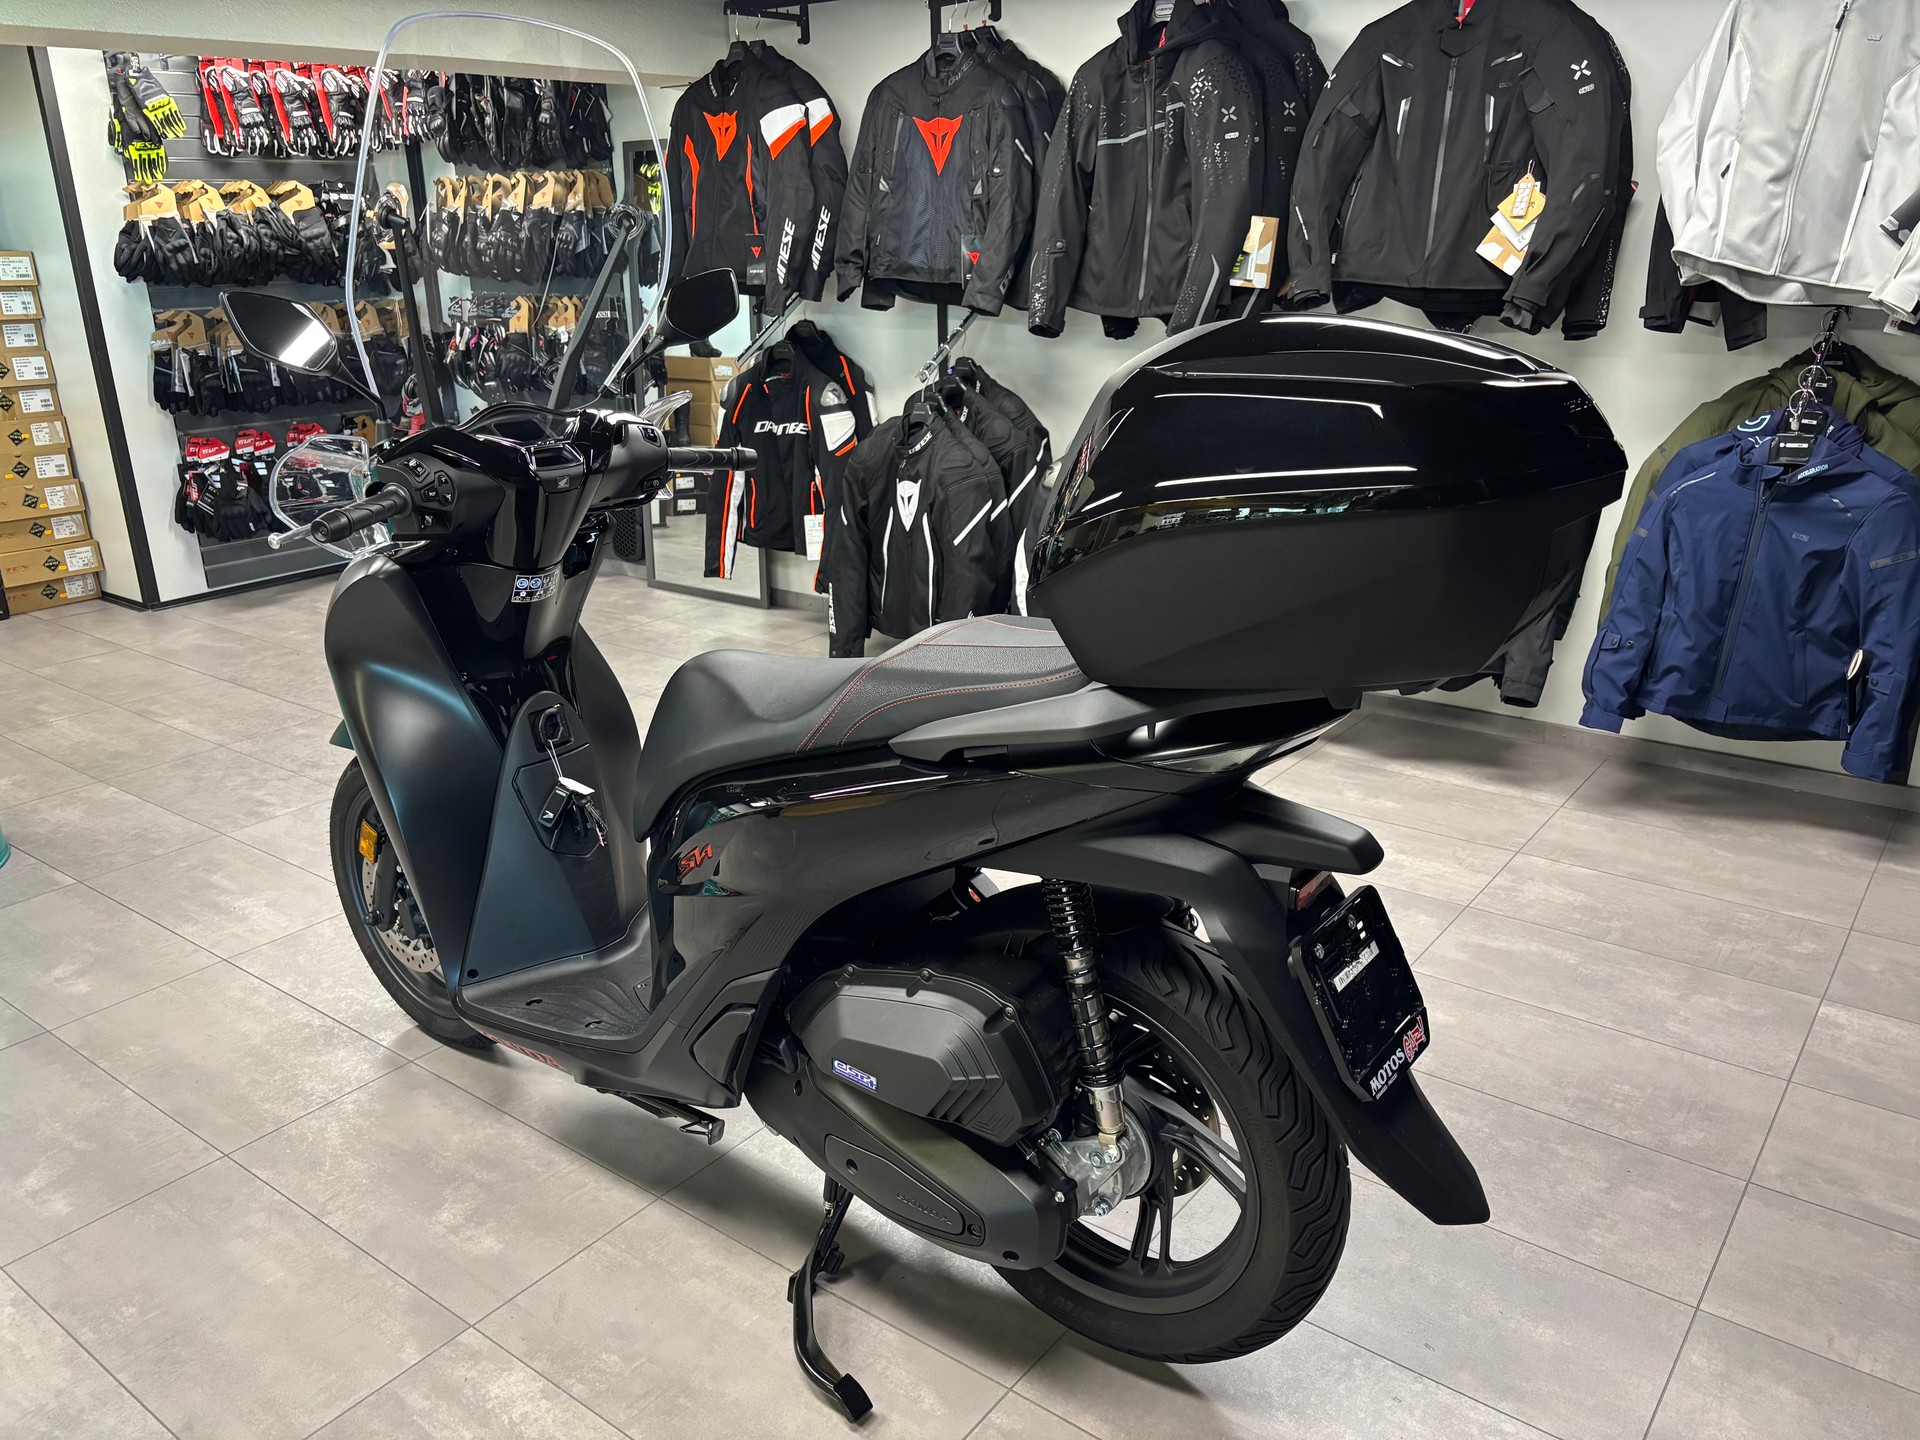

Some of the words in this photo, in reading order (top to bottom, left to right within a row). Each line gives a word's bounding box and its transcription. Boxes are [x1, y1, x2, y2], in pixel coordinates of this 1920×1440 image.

[776, 217, 796, 285] INESE
[811, 205, 831, 271] INESE
[1797, 463, 1829, 480] ACCELERATION
[1370, 1047, 1405, 1096] MOTOS
